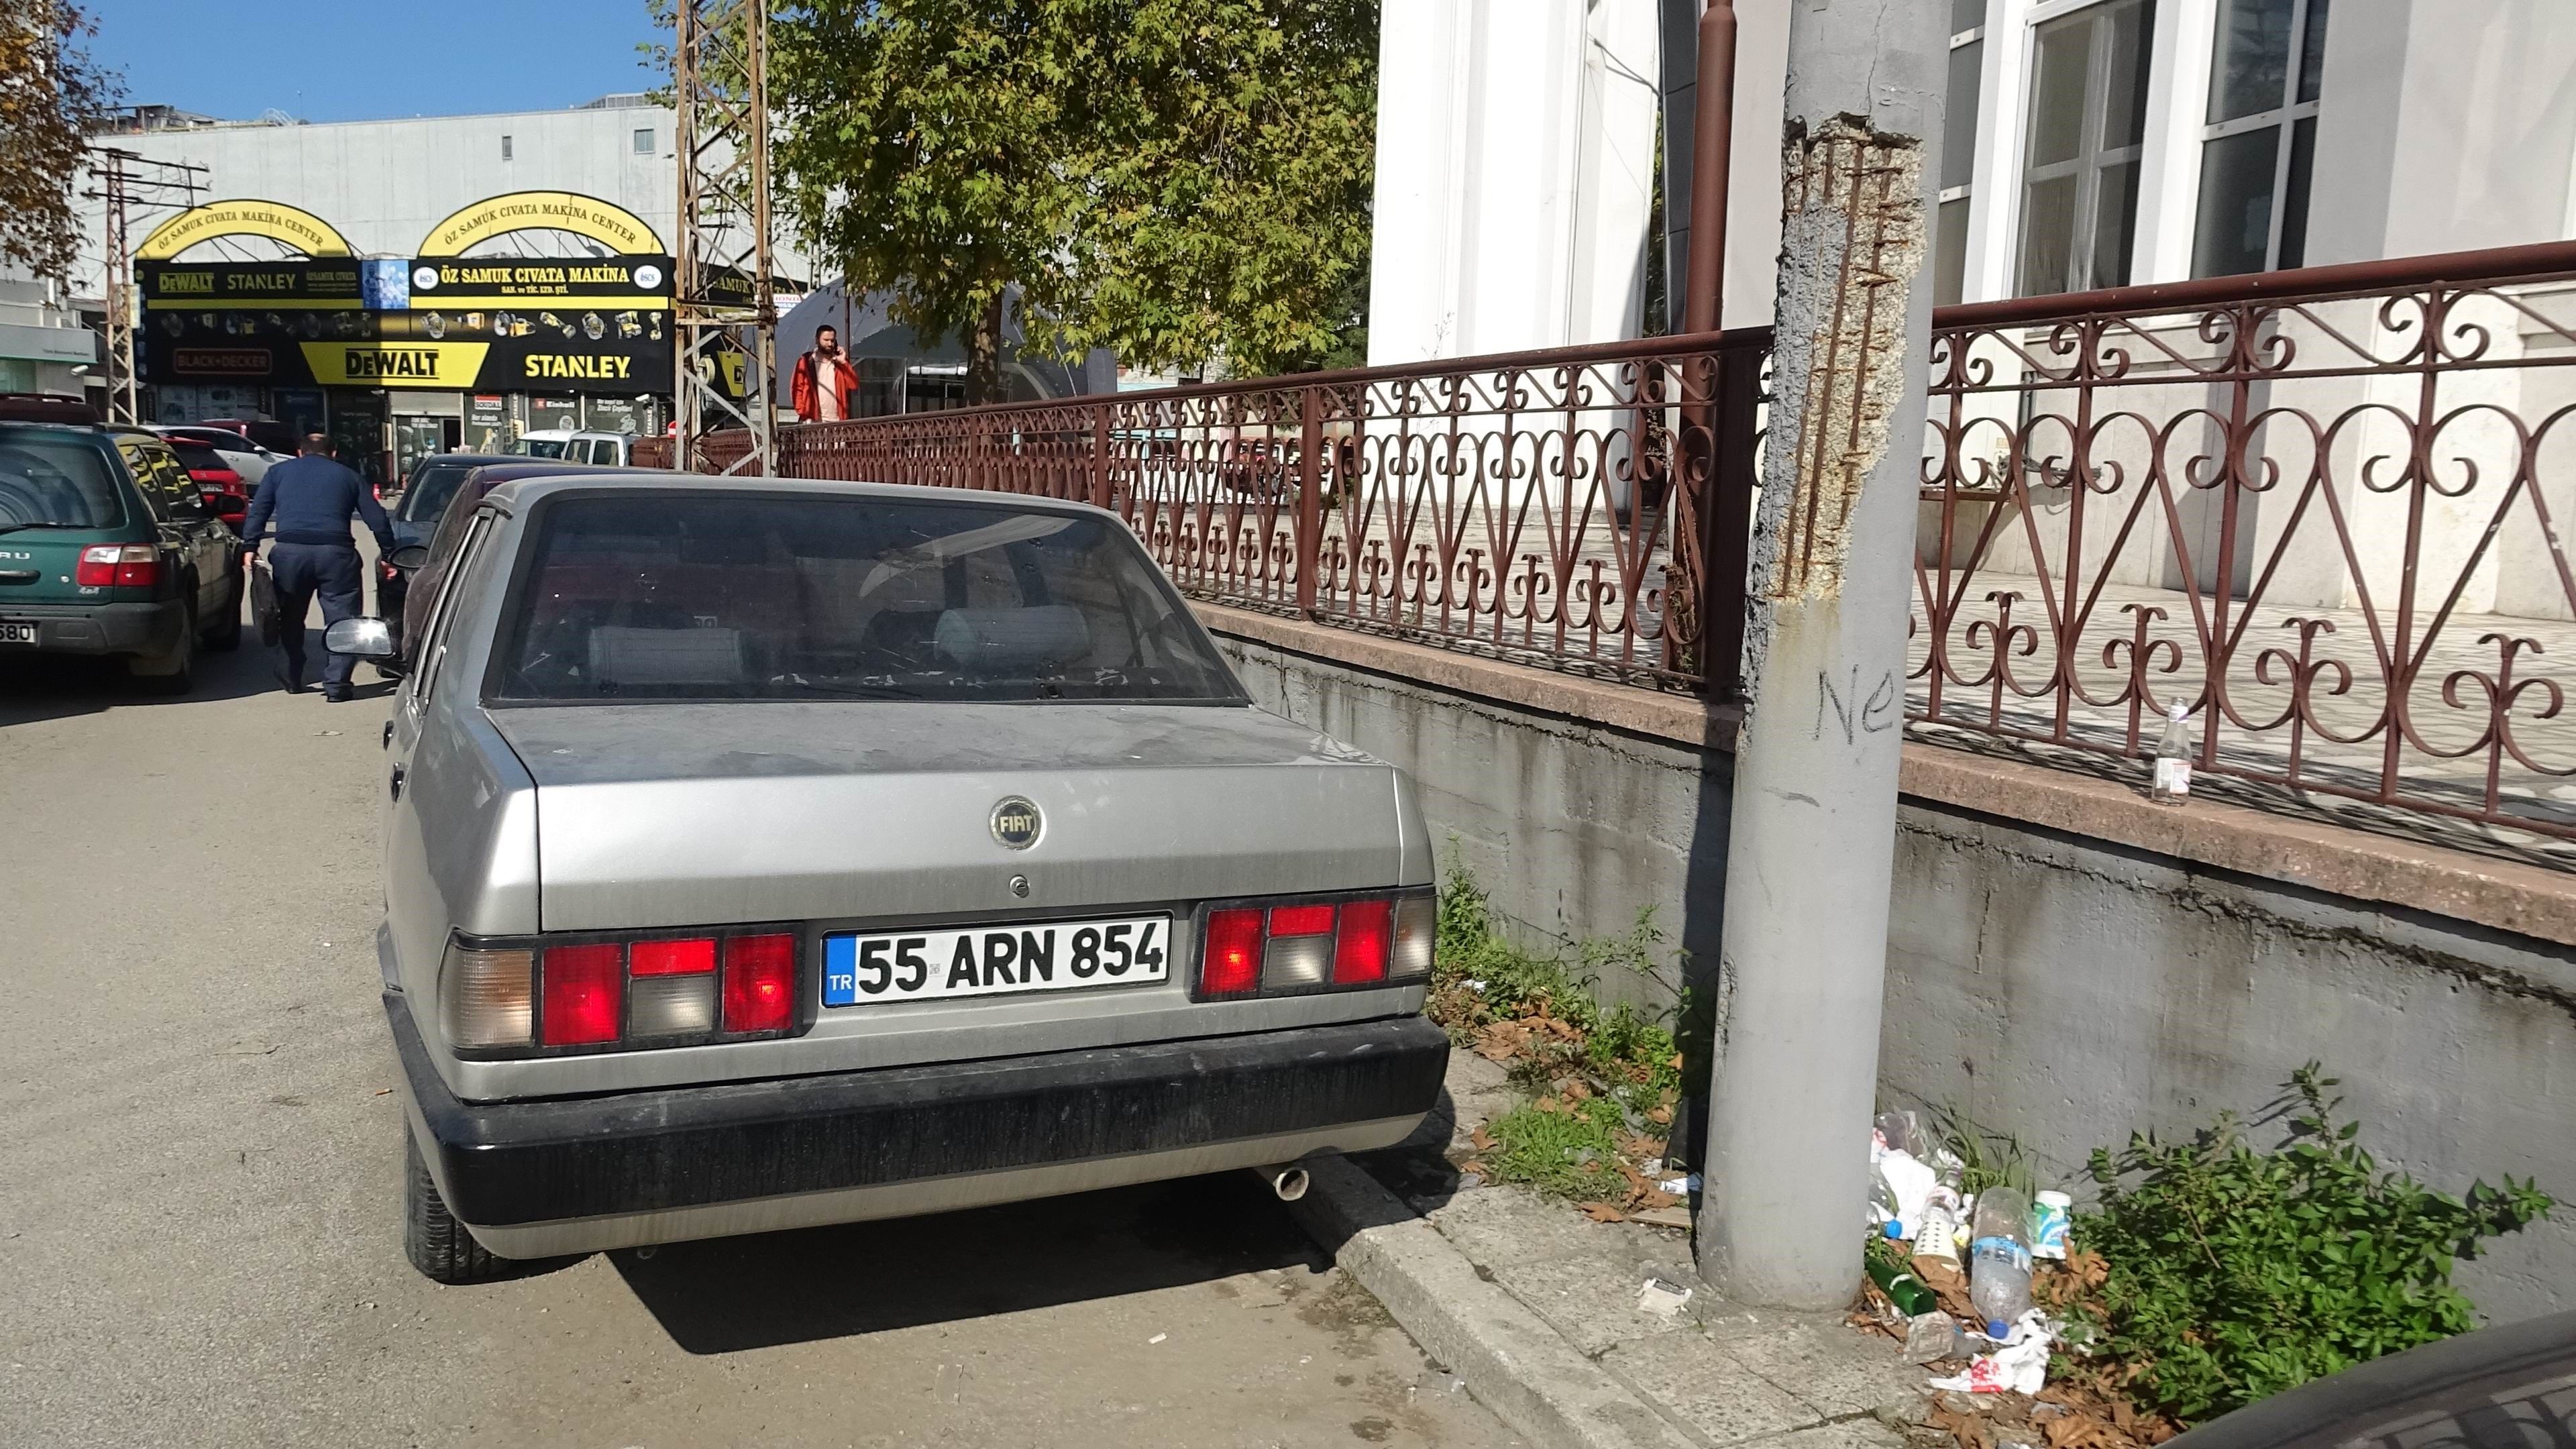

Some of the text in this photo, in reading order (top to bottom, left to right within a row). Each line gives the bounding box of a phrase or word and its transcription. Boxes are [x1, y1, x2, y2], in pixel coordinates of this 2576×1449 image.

[158, 237, 170, 250] ÖZ
[171, 217, 204, 240] SAMUK
[205, 211, 237, 224] CIVATA
[285, 219, 324, 247] CENTER
[444, 203, 636, 246] ÖZ SAMUK CIVATA MAKİNA CENTER
[227, 273, 296, 290] STANLEY
[441, 264, 630, 283] ÖZ SAMUK CIVATA MAKİNA
[525, 354, 631, 378] STANLEY
[1812, 663, 1894, 745] Ne
[1000, 814, 1032, 833] FIAT
[859, 922, 1163, 994] 55 ARN 854
[830, 975, 852, 991] TR
